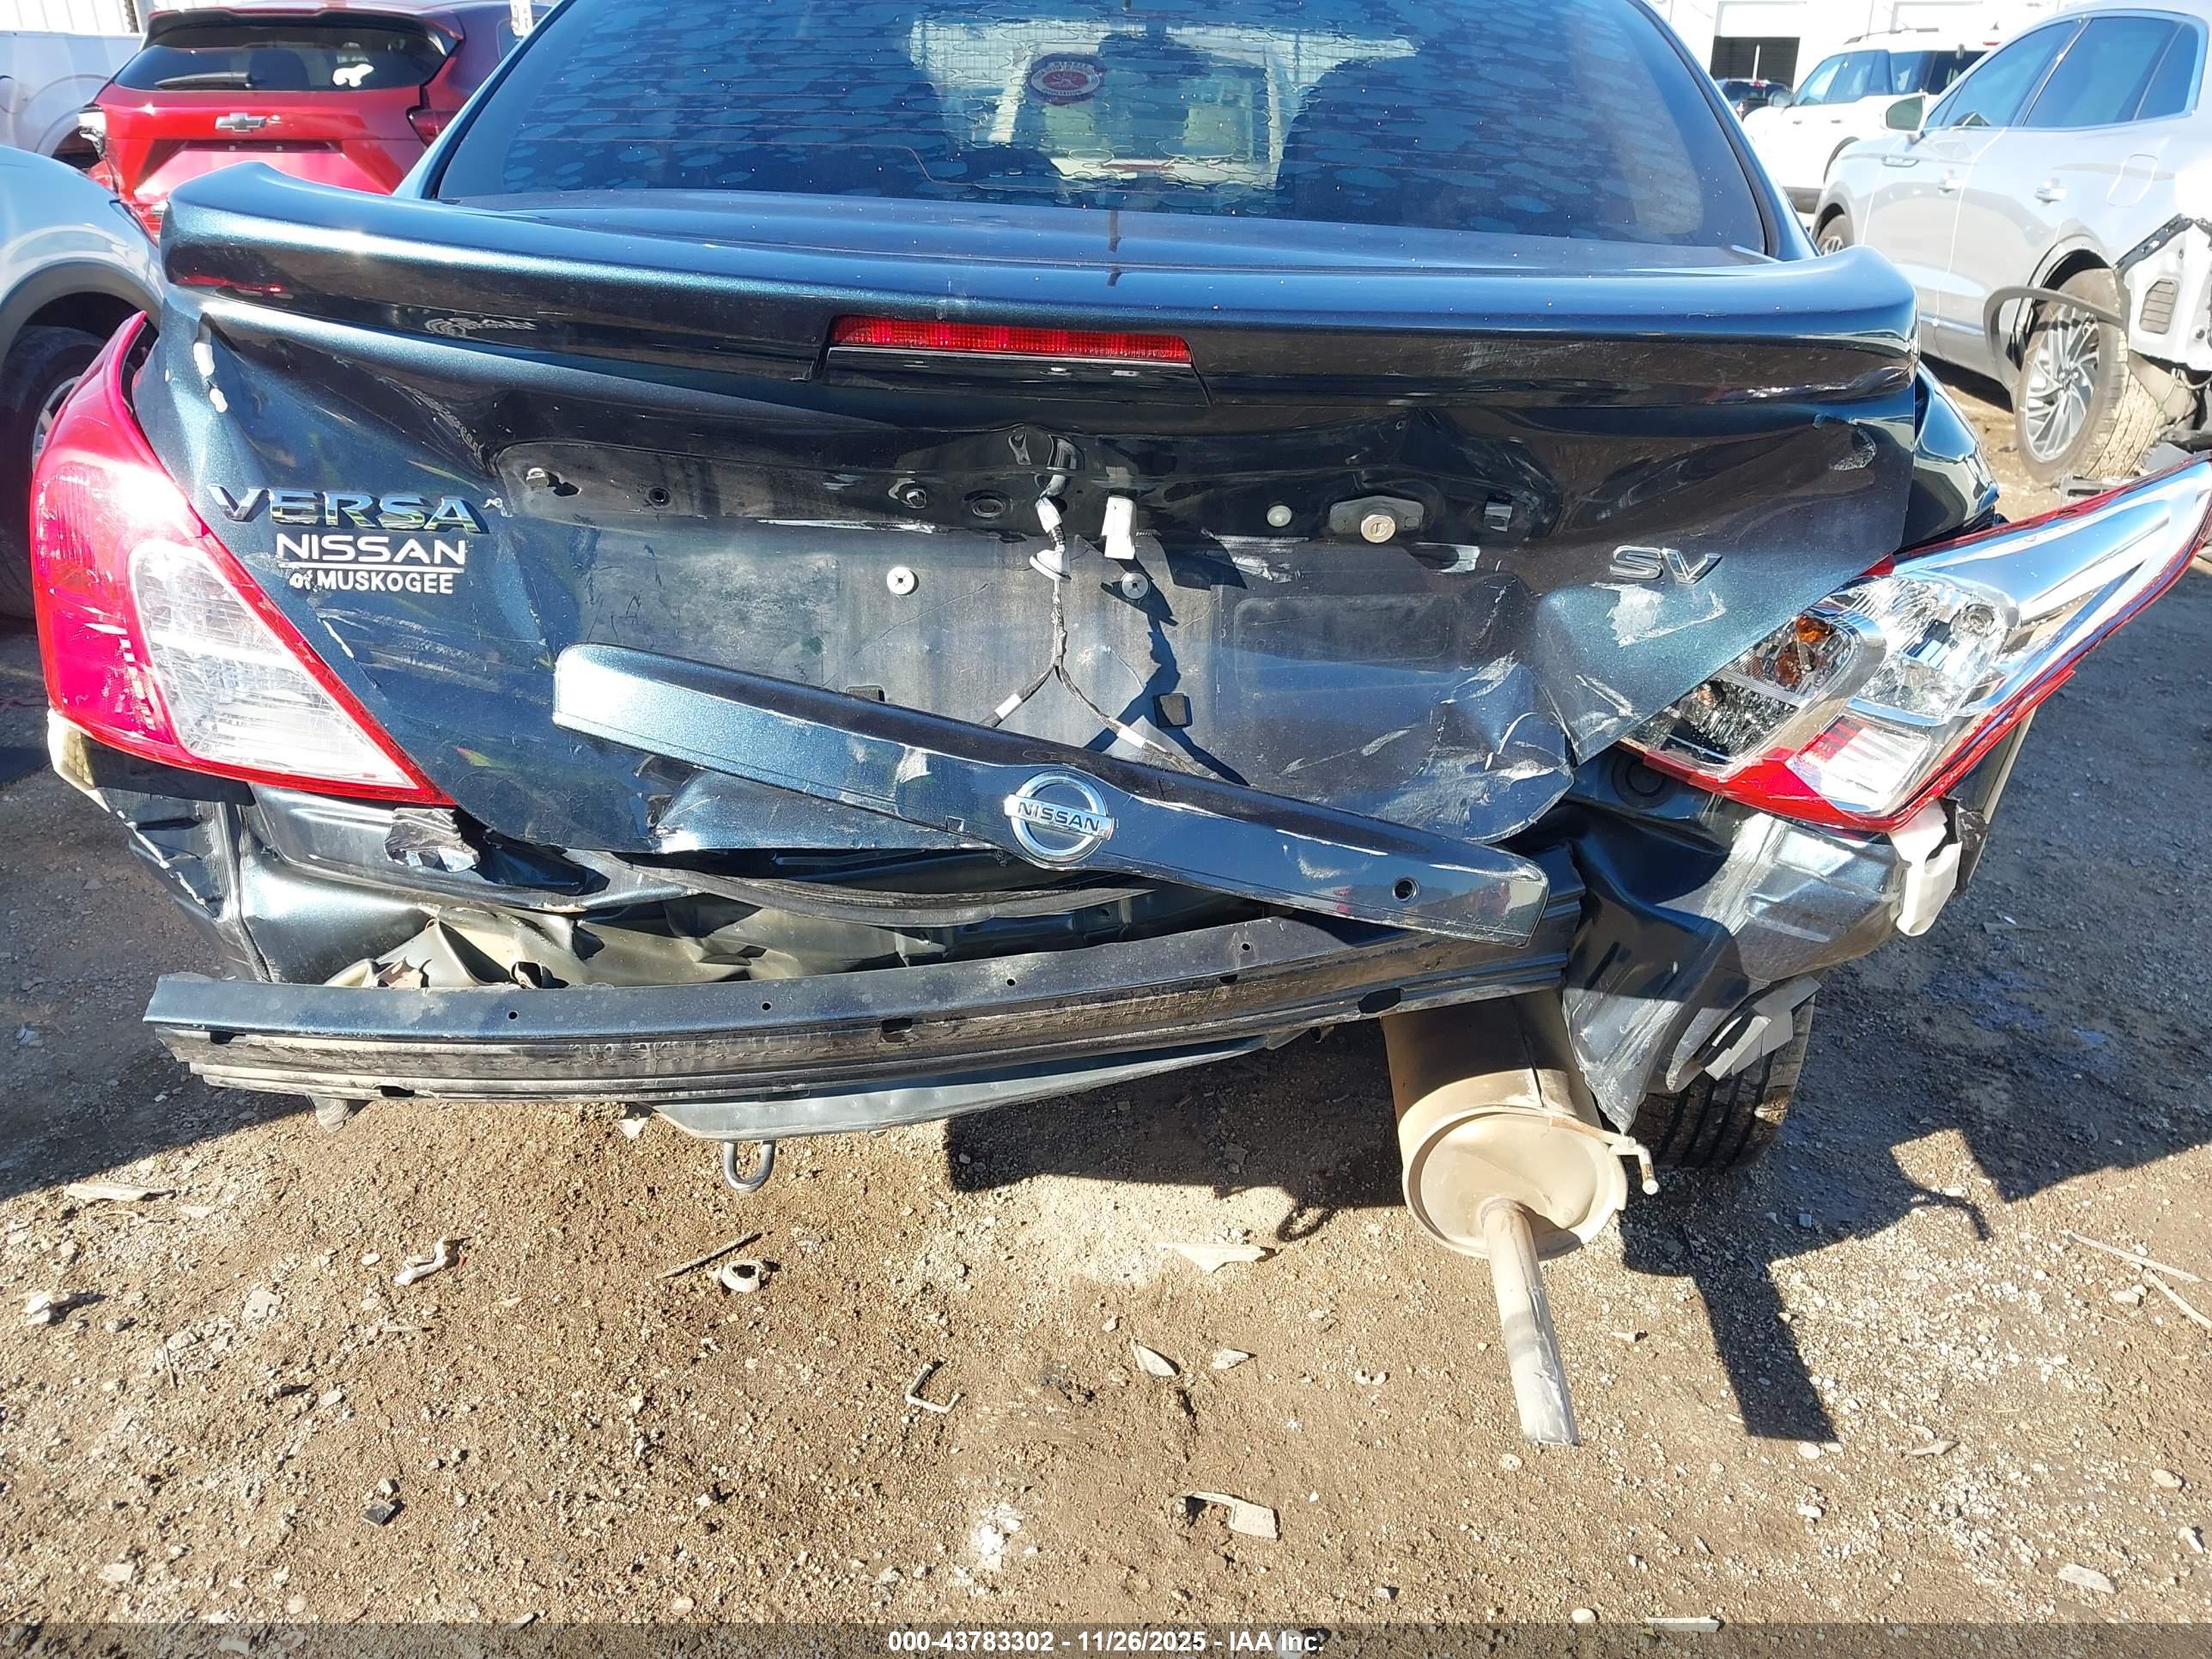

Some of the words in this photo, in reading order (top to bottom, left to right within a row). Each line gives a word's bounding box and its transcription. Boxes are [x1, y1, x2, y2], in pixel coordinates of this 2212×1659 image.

[207, 484, 489, 534] VERSA
[276, 532, 467, 566] NISSAN
[1609, 544, 1723, 585] SV
[289, 571, 313, 591] of
[318, 570, 454, 594] MUSKOGEE
[1017, 801, 1100, 832] NISSAN
